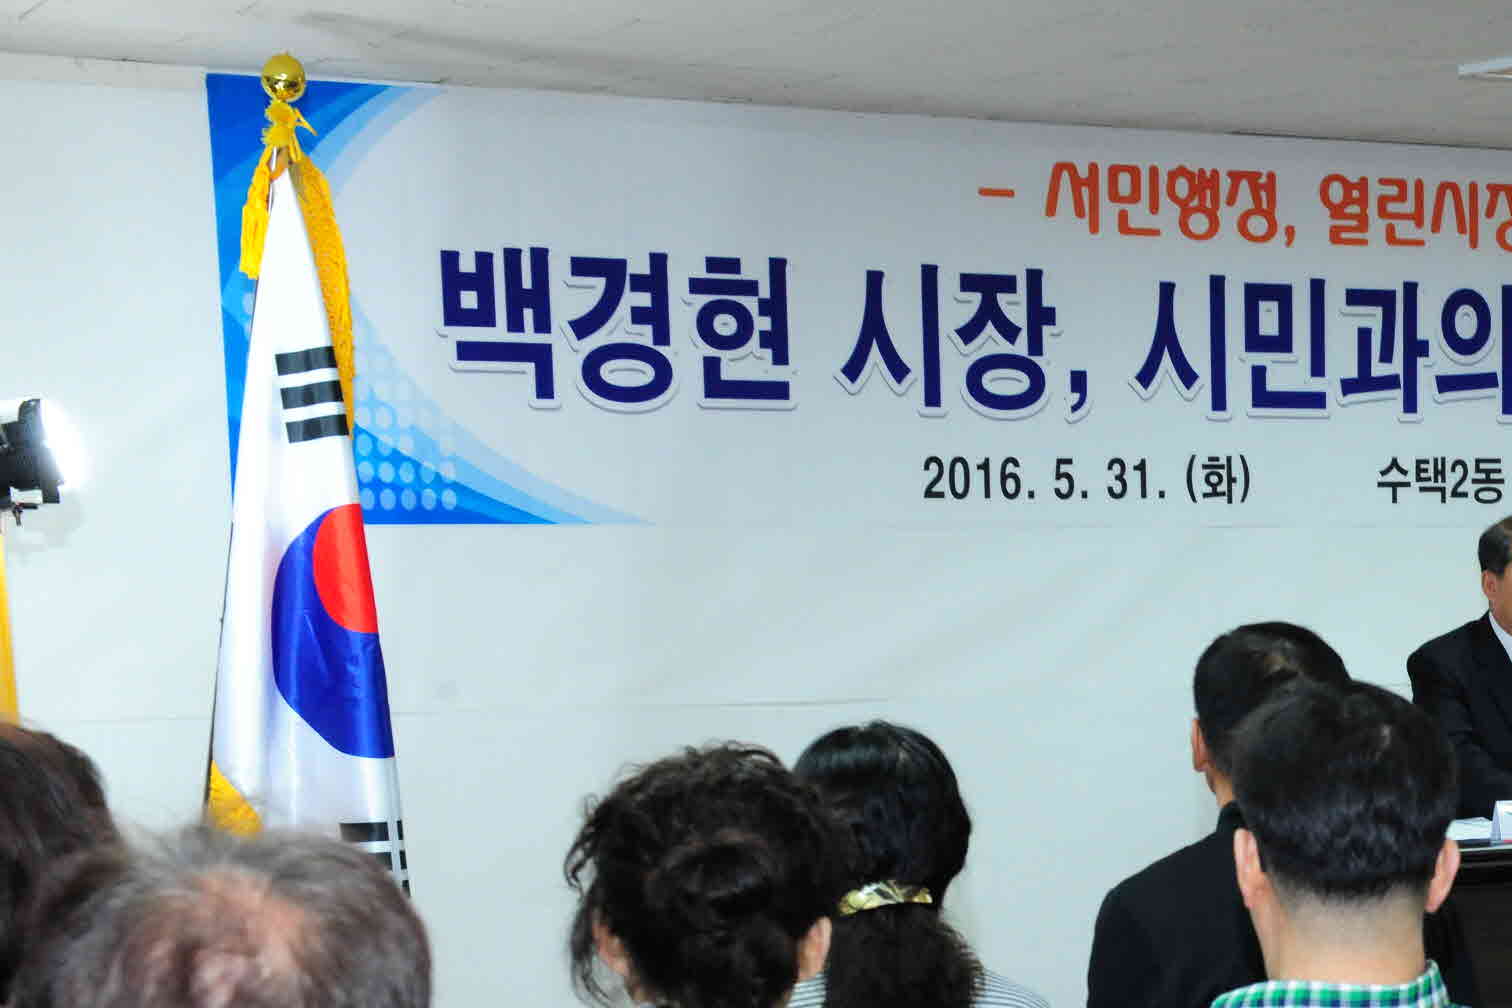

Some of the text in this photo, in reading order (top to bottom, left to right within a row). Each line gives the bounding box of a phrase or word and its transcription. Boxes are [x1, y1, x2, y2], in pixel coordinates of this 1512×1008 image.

[1045, 161, 1296, 247] 서민행정,
[439, 246, 791, 403] 백경현
[841, 263, 1089, 413] 시장,
[922, 455, 1036, 501] 2016.
[1106, 456, 1167, 500] 31.
[1185, 454, 1251, 505] (화)
[1376, 456, 1506, 505] 수택2동
